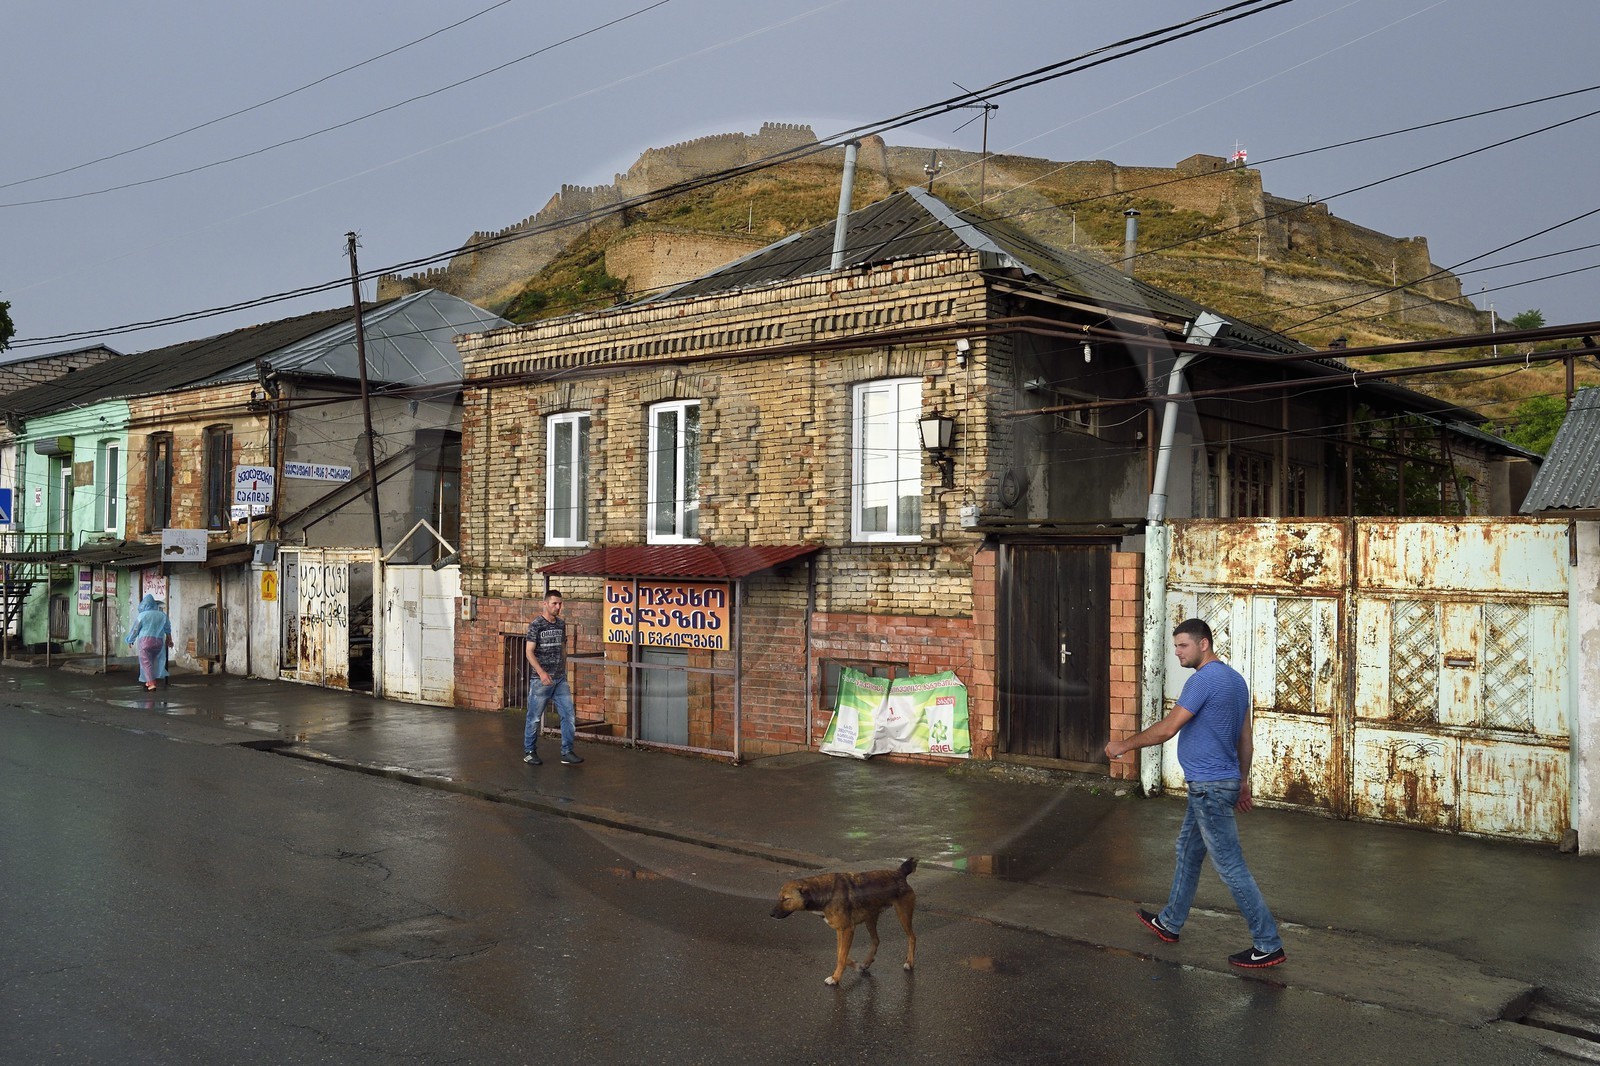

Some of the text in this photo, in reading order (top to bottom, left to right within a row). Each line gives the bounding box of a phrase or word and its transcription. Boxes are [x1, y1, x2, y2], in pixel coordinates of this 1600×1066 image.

[237, 468, 273, 486] ყველაფერი
[252, 480, 258, 491] 1
[237, 491, 270, 503] ლარიდან
[606, 585, 725, 608] საოჯახო
[610, 607, 722, 630] მაღაზია
[608, 629, 724, 649] ათაი წვრილმანი
[889, 707, 894, 715] 1
[930, 744, 953, 753] ARIEL
